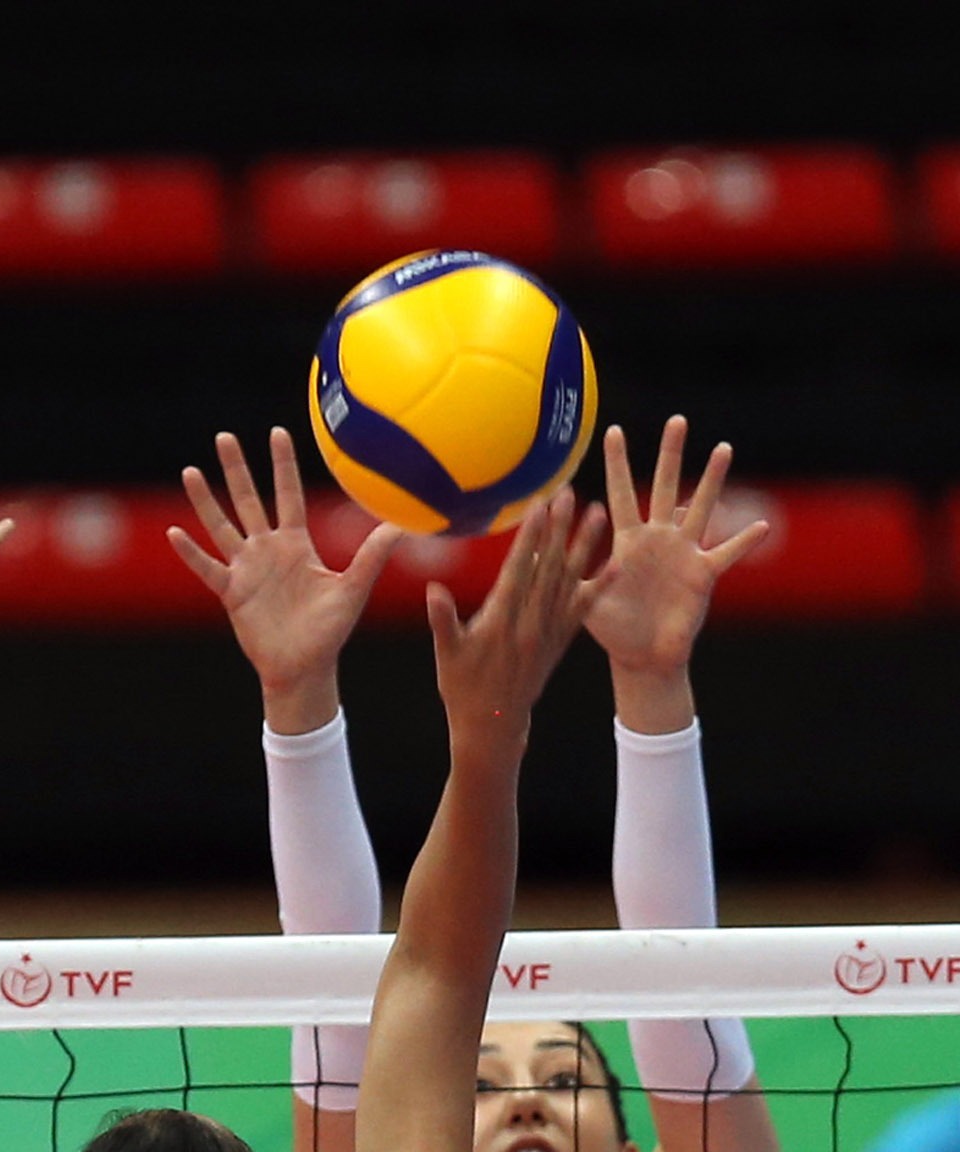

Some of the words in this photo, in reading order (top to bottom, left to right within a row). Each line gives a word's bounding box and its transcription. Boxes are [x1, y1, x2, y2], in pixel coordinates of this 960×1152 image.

[60, 970, 133, 997] TVF
[500, 963, 551, 990] VF
[894, 956, 960, 984] TVF
